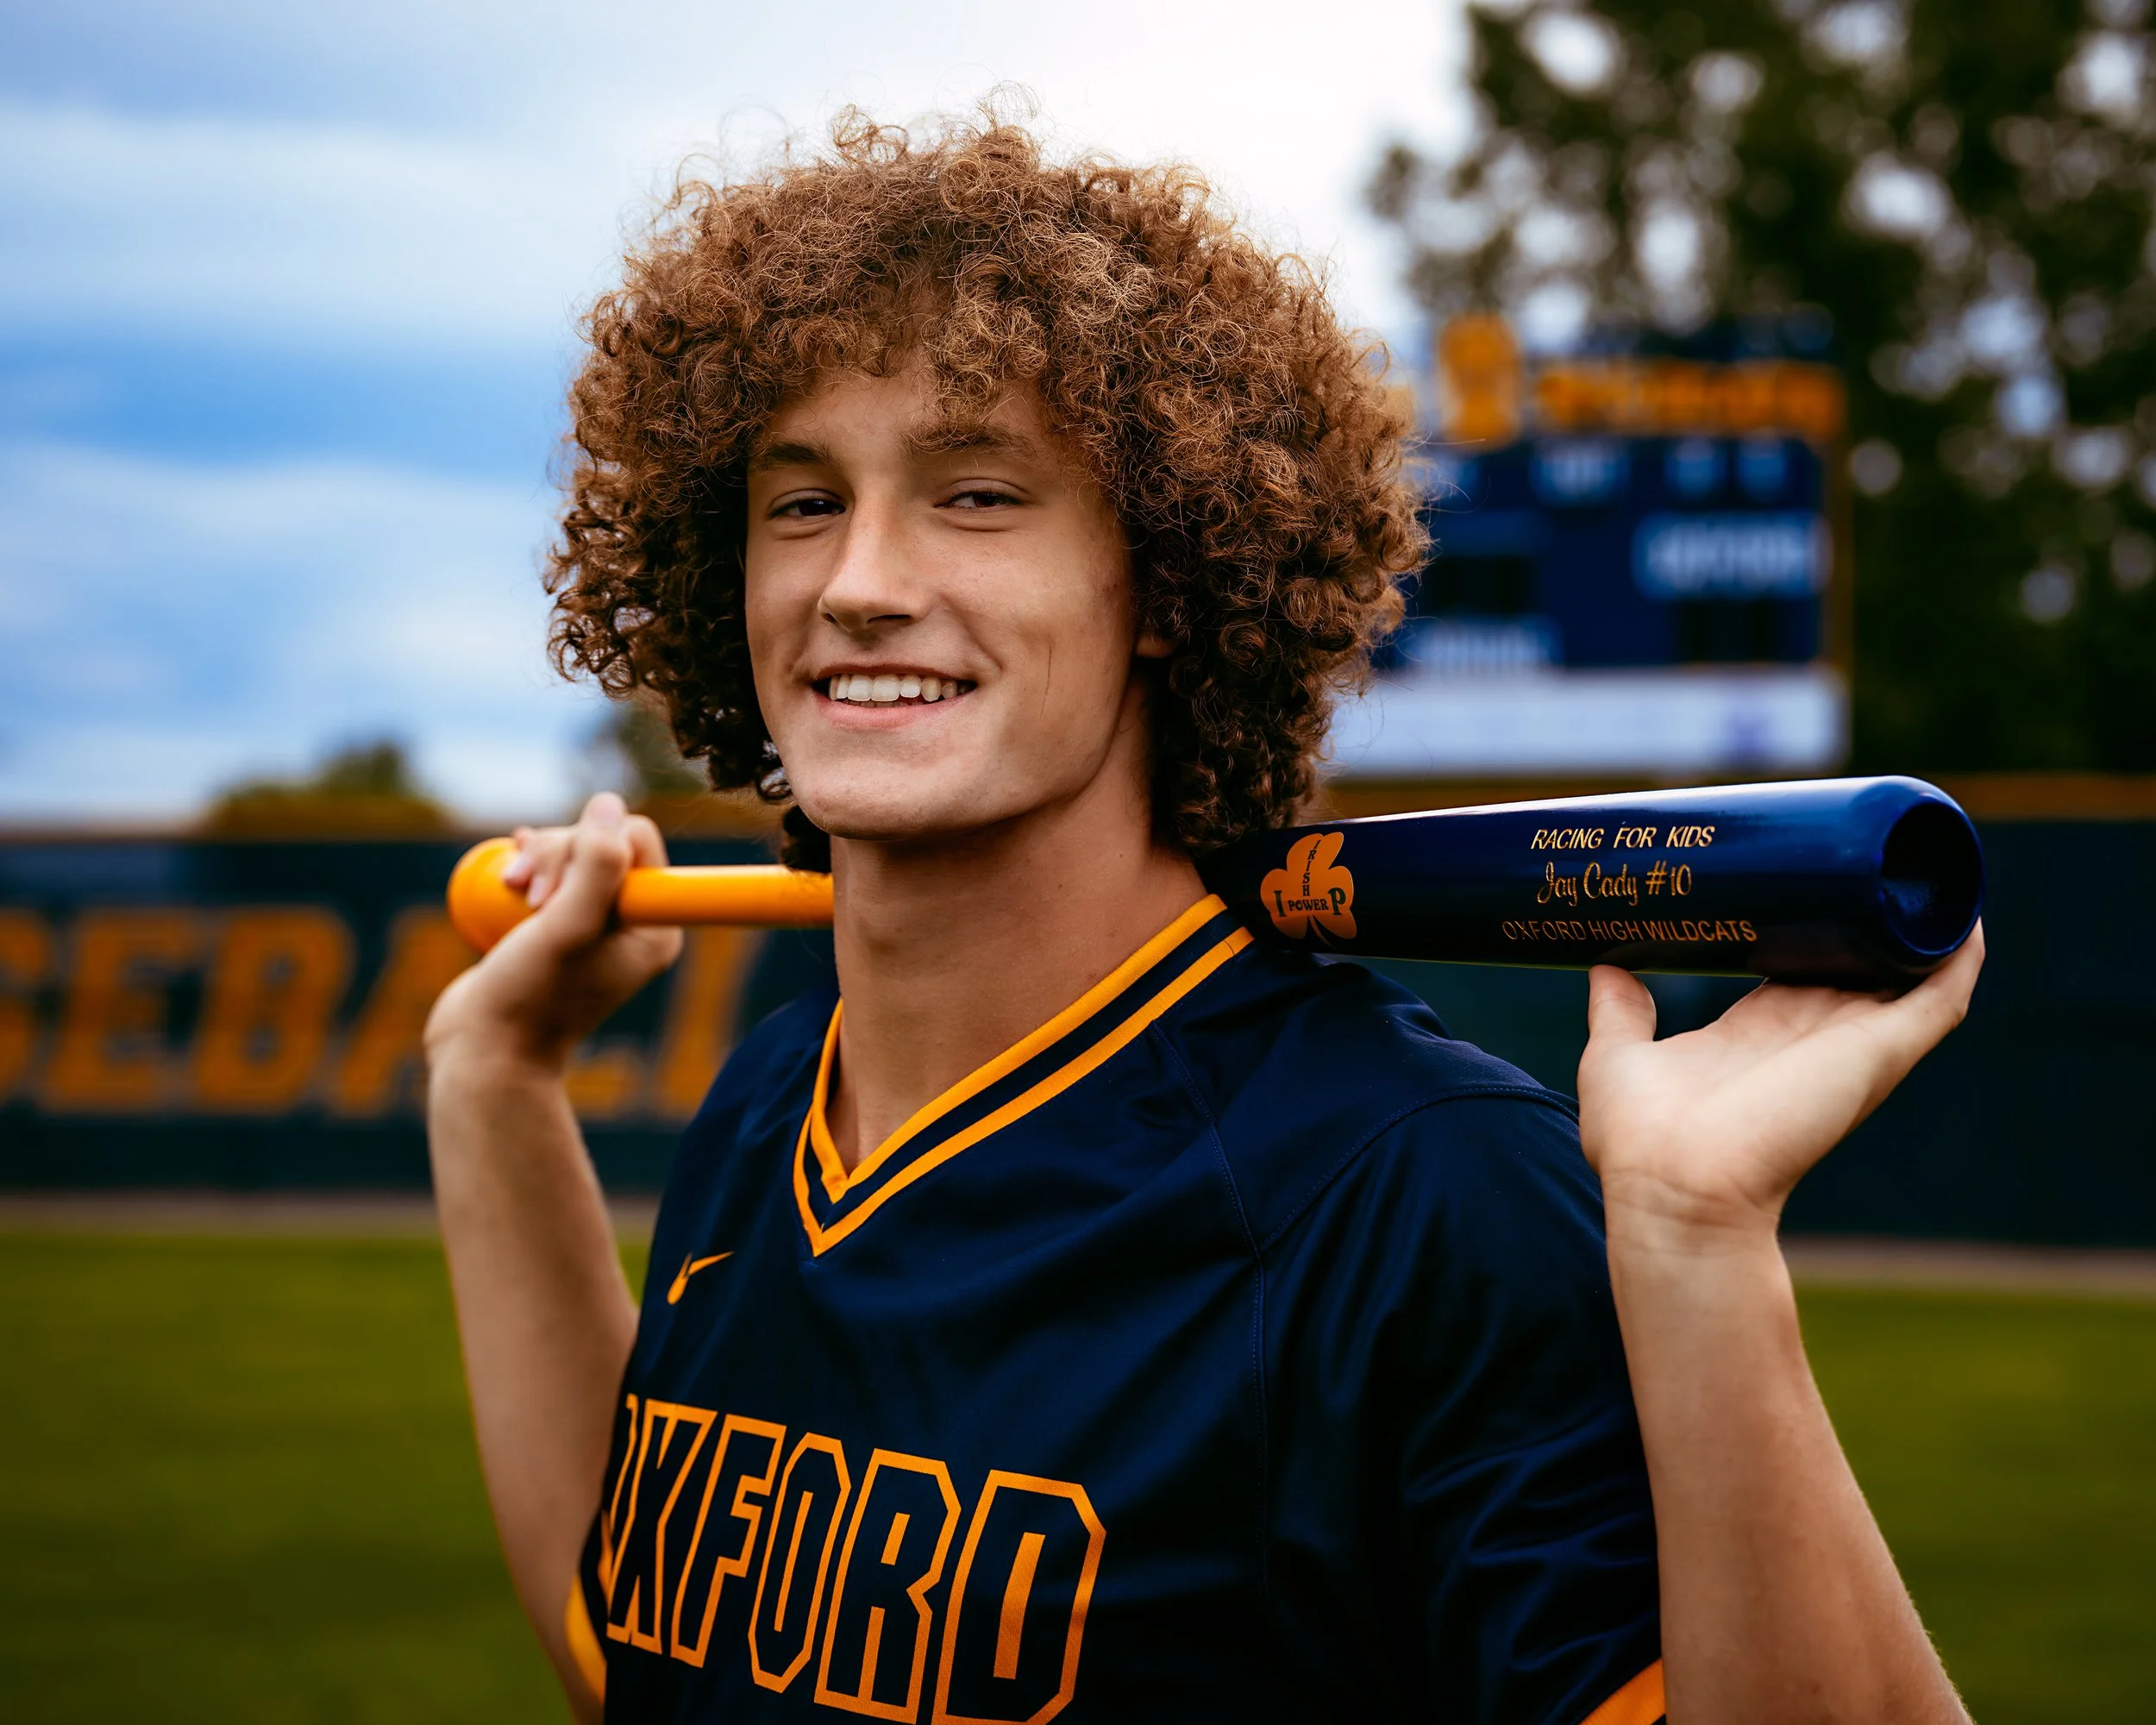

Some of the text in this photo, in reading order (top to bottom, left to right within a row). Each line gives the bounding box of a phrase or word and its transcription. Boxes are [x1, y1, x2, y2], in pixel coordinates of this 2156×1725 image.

[1531, 825, 1716, 850] RACING FOR KIDS
[1301, 839, 1322, 897] IRISH
[1537, 860, 1693, 906] Jay Cady #10
[1287, 898, 1329, 912] POWER
[1327, 887, 1347, 916] P
[1501, 919, 1758, 942] OXFORD HIGH WILDCATS
[599, 1393, 1106, 1725] XFORD
